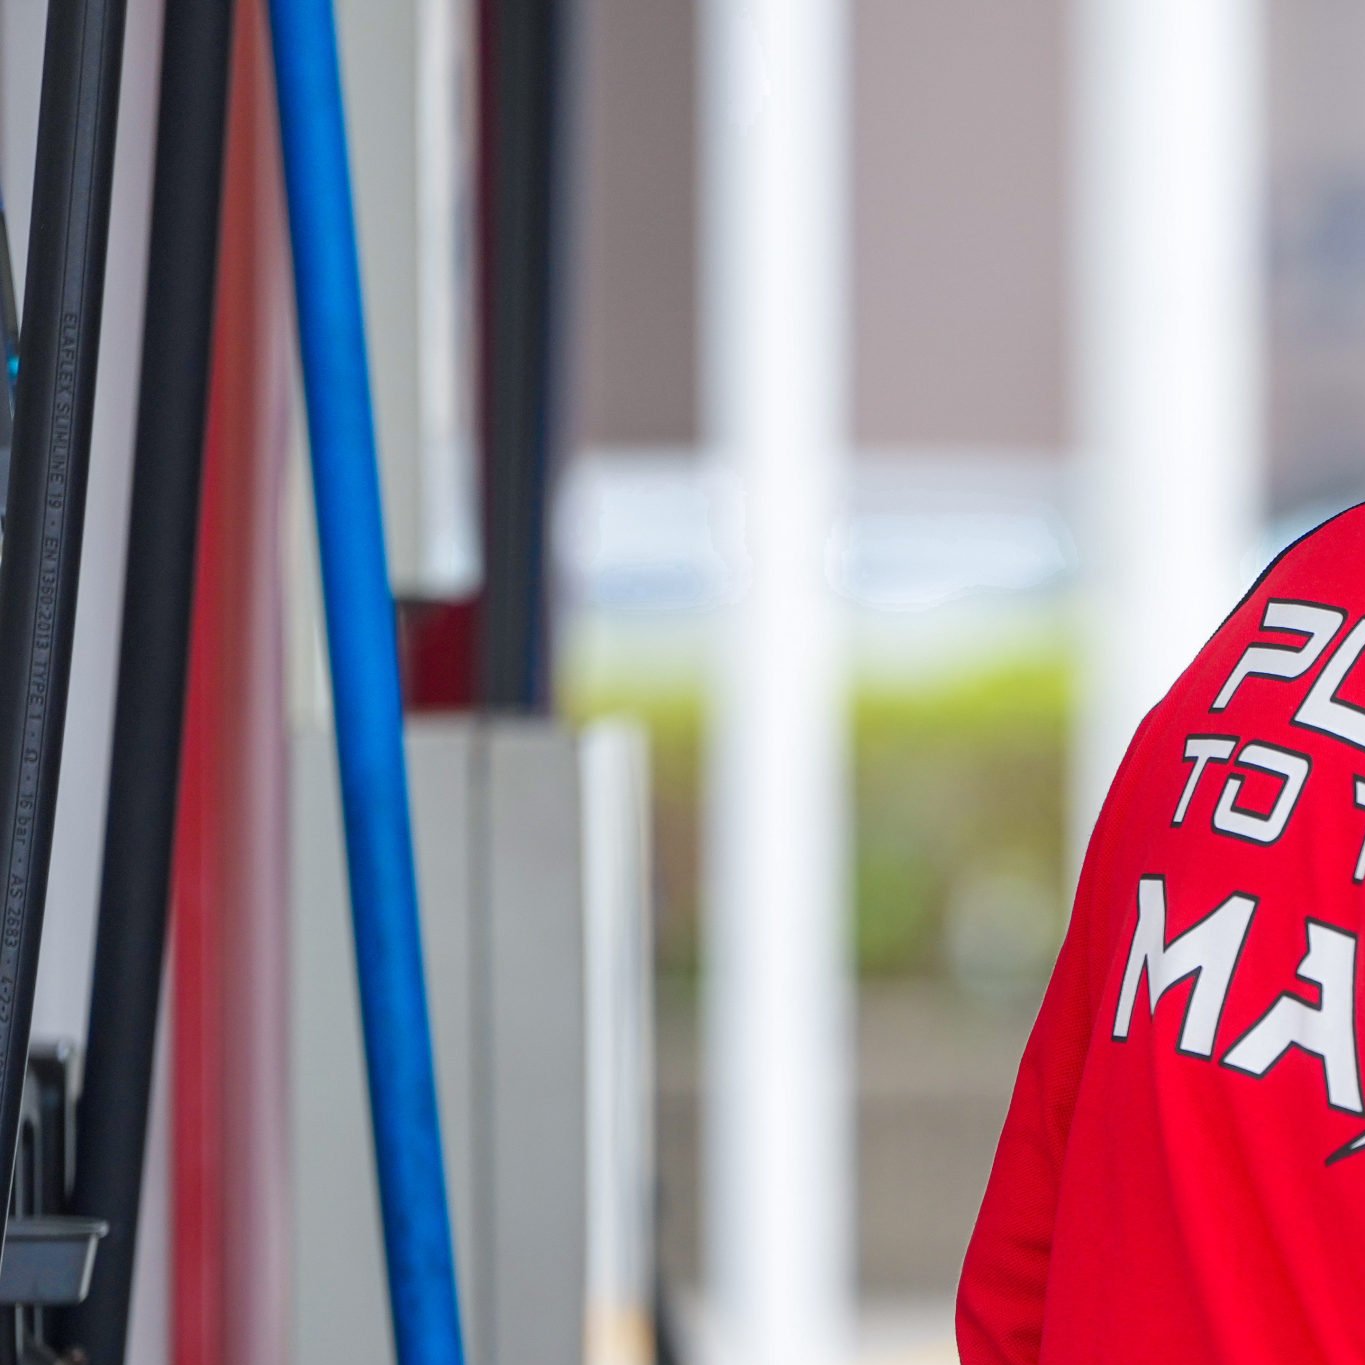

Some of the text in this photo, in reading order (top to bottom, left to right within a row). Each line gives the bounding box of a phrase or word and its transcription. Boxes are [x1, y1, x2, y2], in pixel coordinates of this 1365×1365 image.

[58, 313, 78, 395] ELAFLEX
[50, 403, 71, 486] SLIMLINE
[48, 493, 62, 510] 19
[44, 537, 58, 562] EN
[29, 661, 47, 706] TYPE
[1172, 733, 1313, 847] TO
[15, 816, 32, 846] bar
[9, 873, 24, 899] AS
